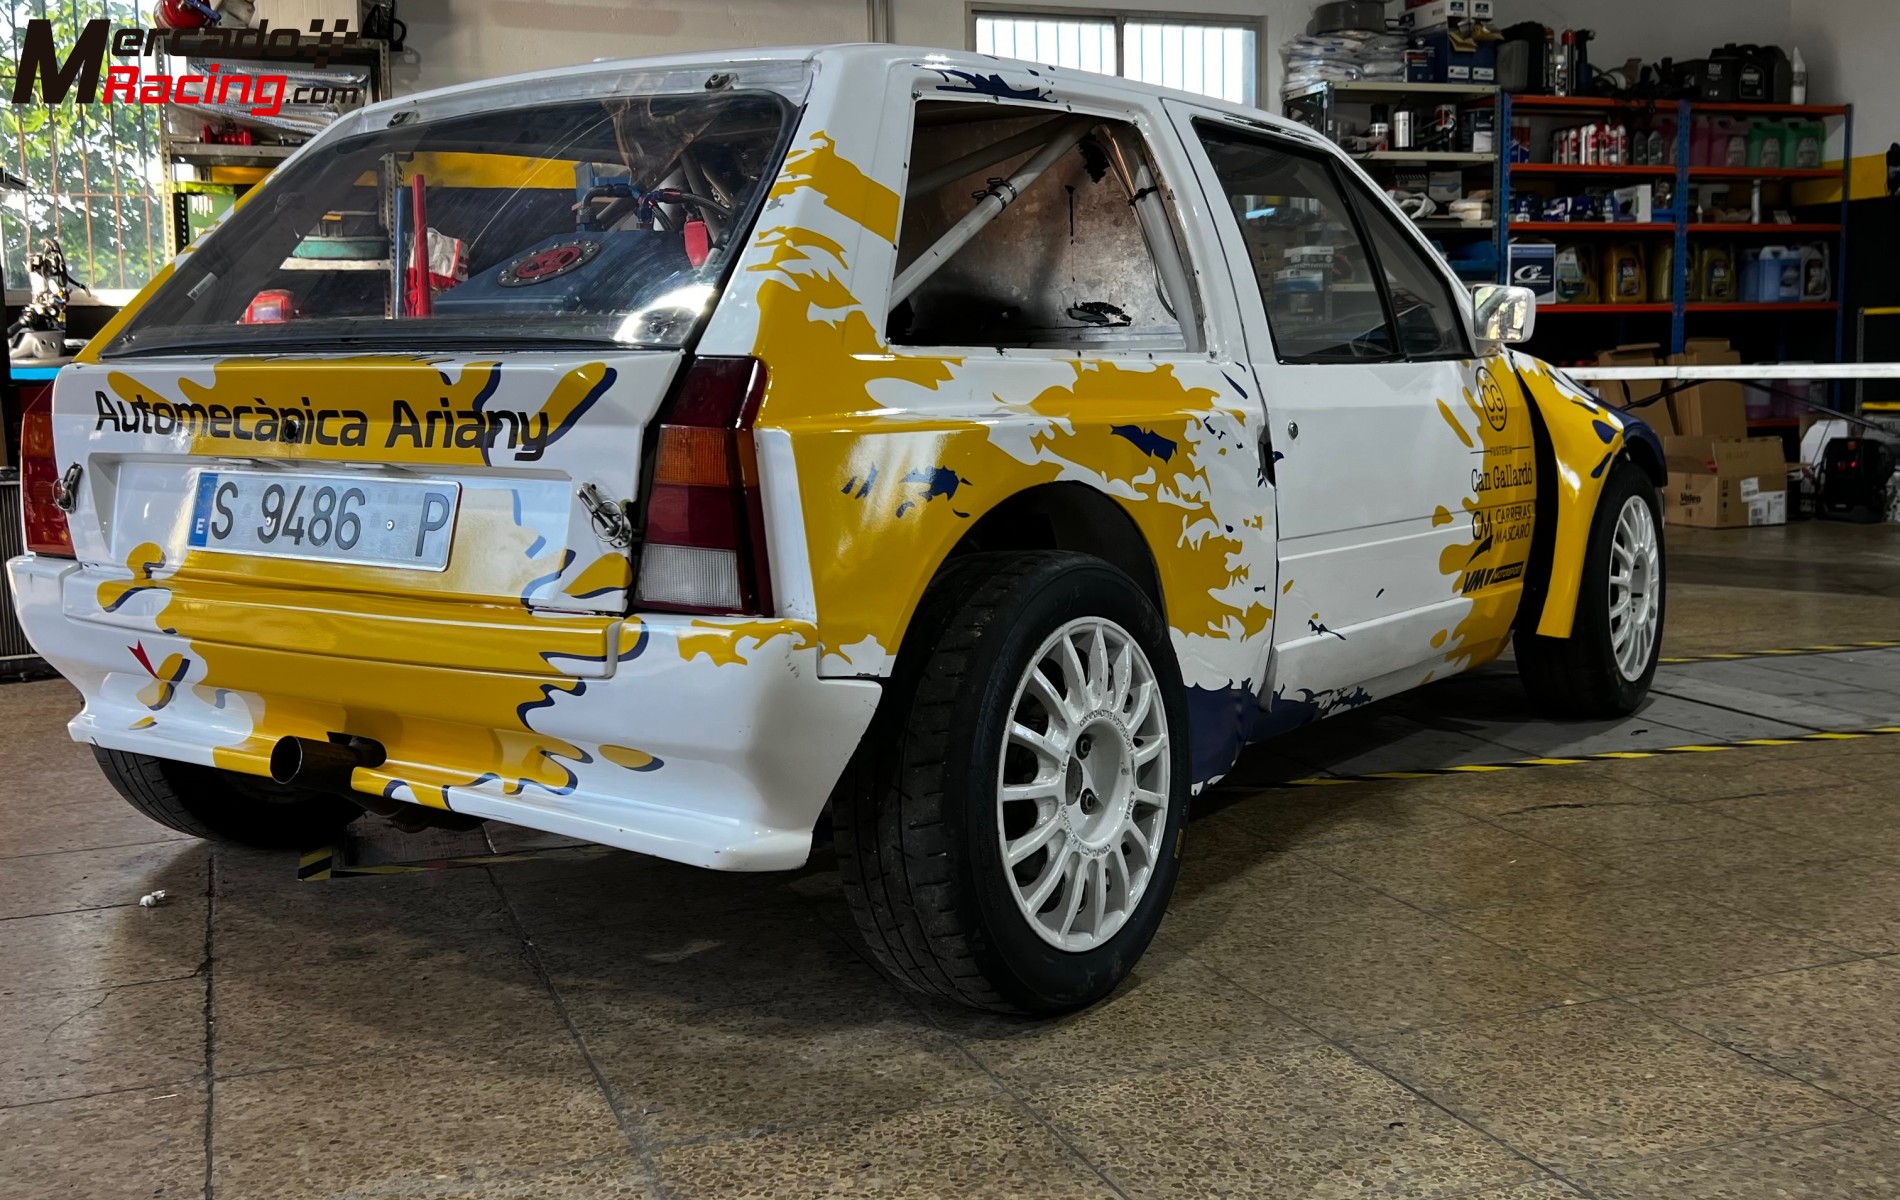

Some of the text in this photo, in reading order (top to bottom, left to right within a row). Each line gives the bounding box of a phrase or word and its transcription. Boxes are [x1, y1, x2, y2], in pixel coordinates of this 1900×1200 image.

[1482, 384, 1504, 412] CG
[95, 391, 549, 462] Automecànica Ariany
[1490, 445, 1513, 457] FUSTERIA
[1471, 461, 1533, 493] Can Gallardó
[1680, 492, 1701, 504] Valeo
[195, 517, 210, 535] E
[211, 481, 450, 557] S 9486 P
[1471, 508, 1493, 540] CM
[1495, 504, 1531, 525] CARRERAS
[1493, 563, 1523, 580] MOTORSPORT
